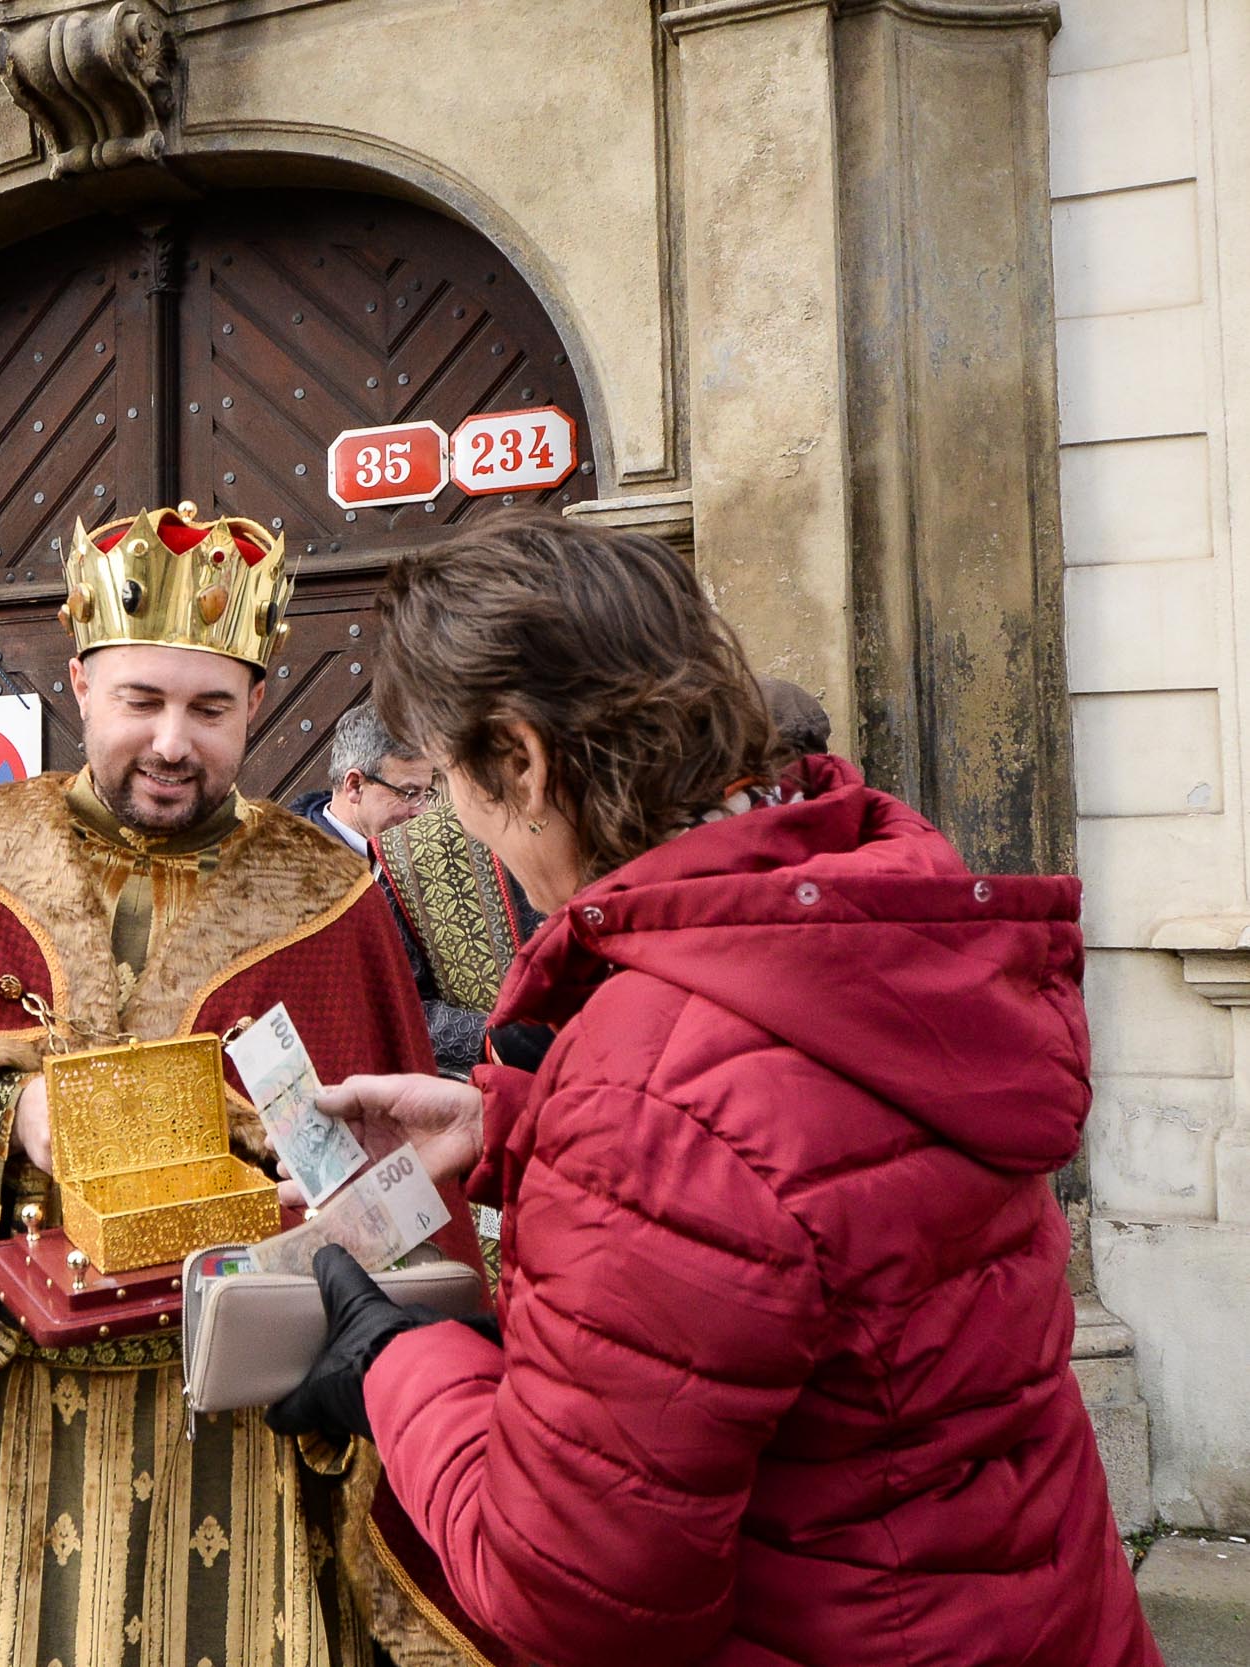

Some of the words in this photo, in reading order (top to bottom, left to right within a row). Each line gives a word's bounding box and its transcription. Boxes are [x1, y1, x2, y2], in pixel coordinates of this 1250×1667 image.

[356, 441, 410, 487] 35
[471, 425, 554, 476] 234
[270, 1012, 294, 1050] 100
[376, 1156, 414, 1192] 500
